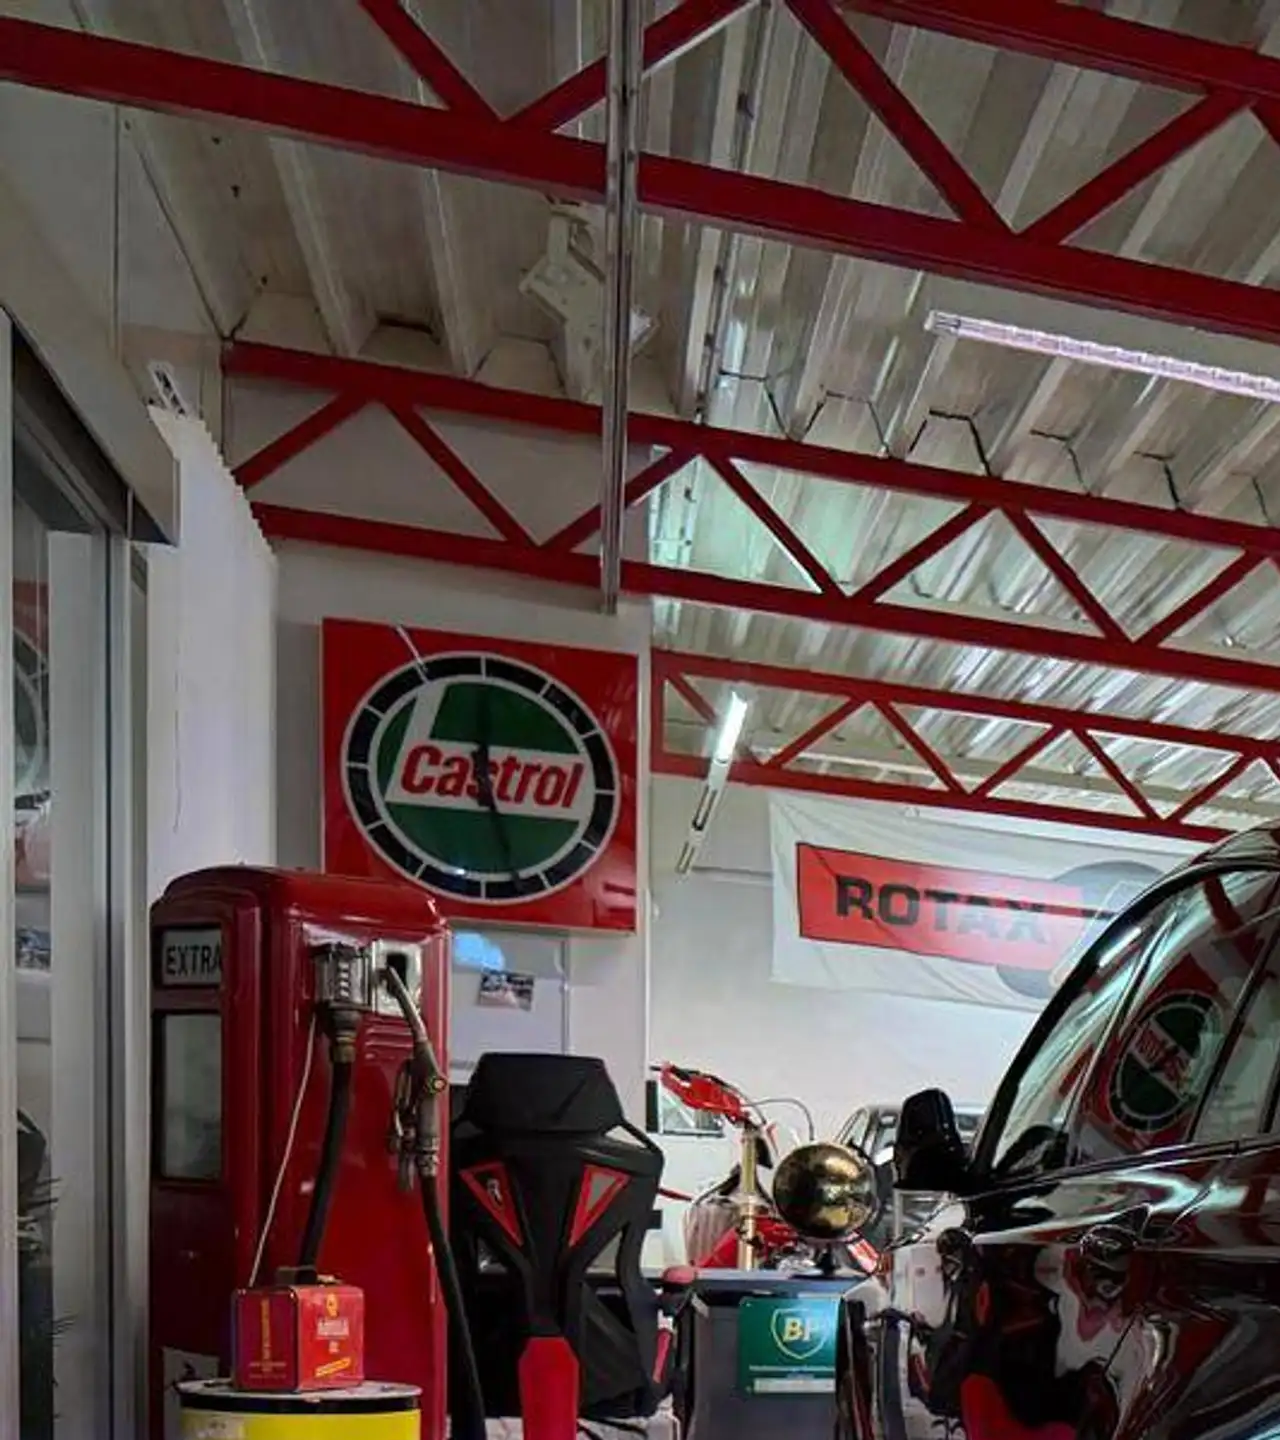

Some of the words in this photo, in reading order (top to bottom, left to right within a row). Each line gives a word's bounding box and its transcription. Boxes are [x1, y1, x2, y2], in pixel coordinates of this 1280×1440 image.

[401, 744, 584, 808] Castrol
[835, 874, 1048, 944] ROTAX
[165, 942, 222, 977] EXTRA
